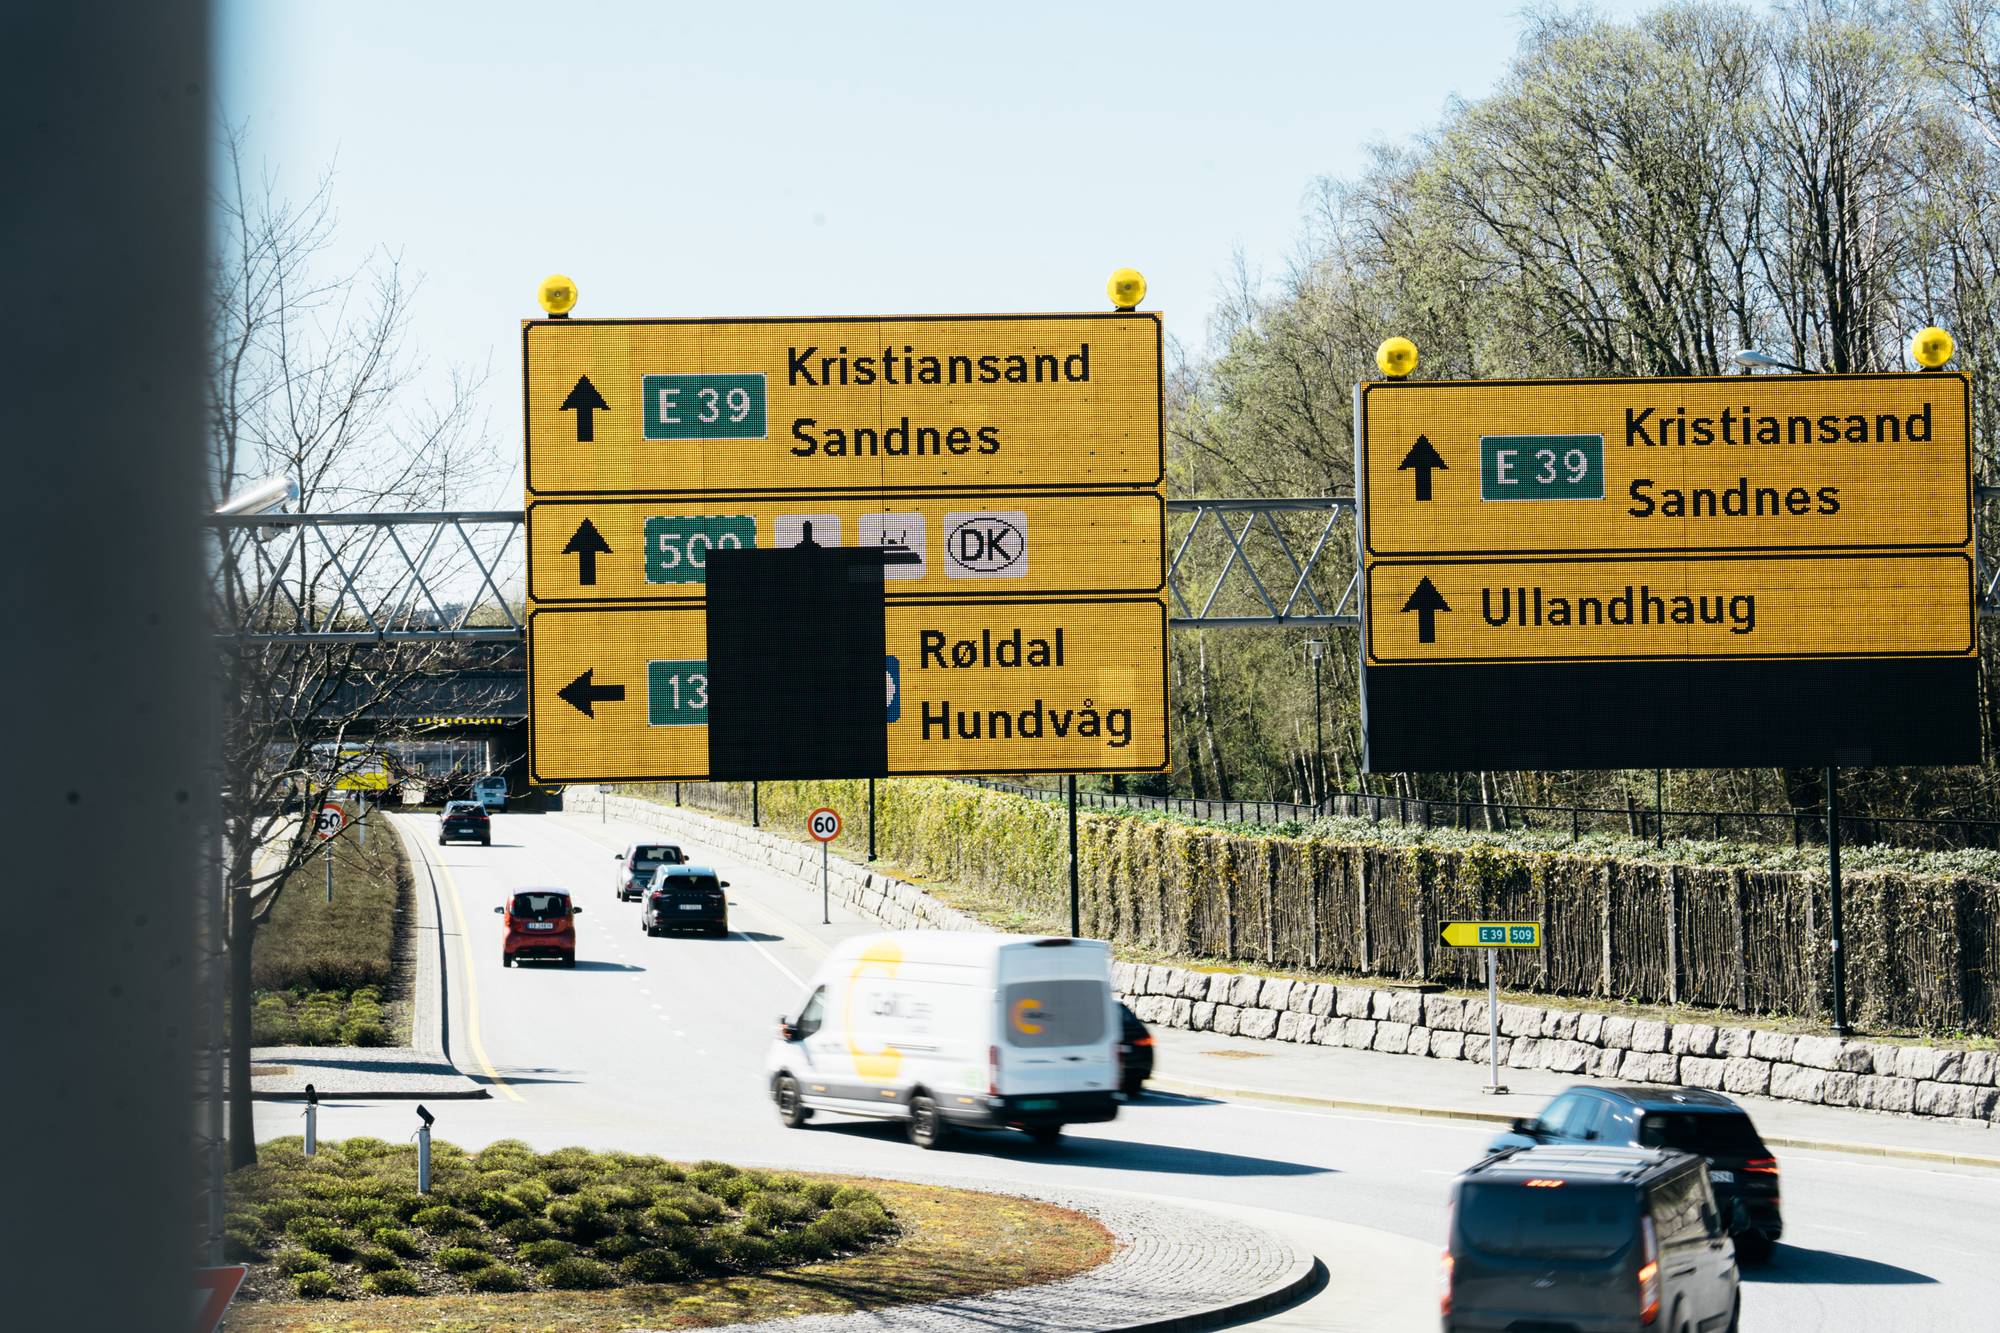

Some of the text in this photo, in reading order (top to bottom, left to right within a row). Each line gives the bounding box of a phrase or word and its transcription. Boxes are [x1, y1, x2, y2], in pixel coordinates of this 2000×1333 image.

[786, 344, 1091, 387] Kristiansand
[659, 387, 751, 424] E 39
[1625, 403, 1932, 447] Kristiansand
[790, 418, 1001, 457] Sandnes
[1497, 449, 1589, 485] E 39
[1628, 477, 1841, 518] Sandnes
[959, 527, 1011, 562] DK
[1482, 585, 1756, 634] Ullandhaug
[919, 628, 1065, 669] Røldal
[669, 674, 709, 709] 13
[921, 697, 1134, 748] Hundvåg
[814, 816, 836, 833] 60
[1481, 929, 1532, 940] E 39 509
